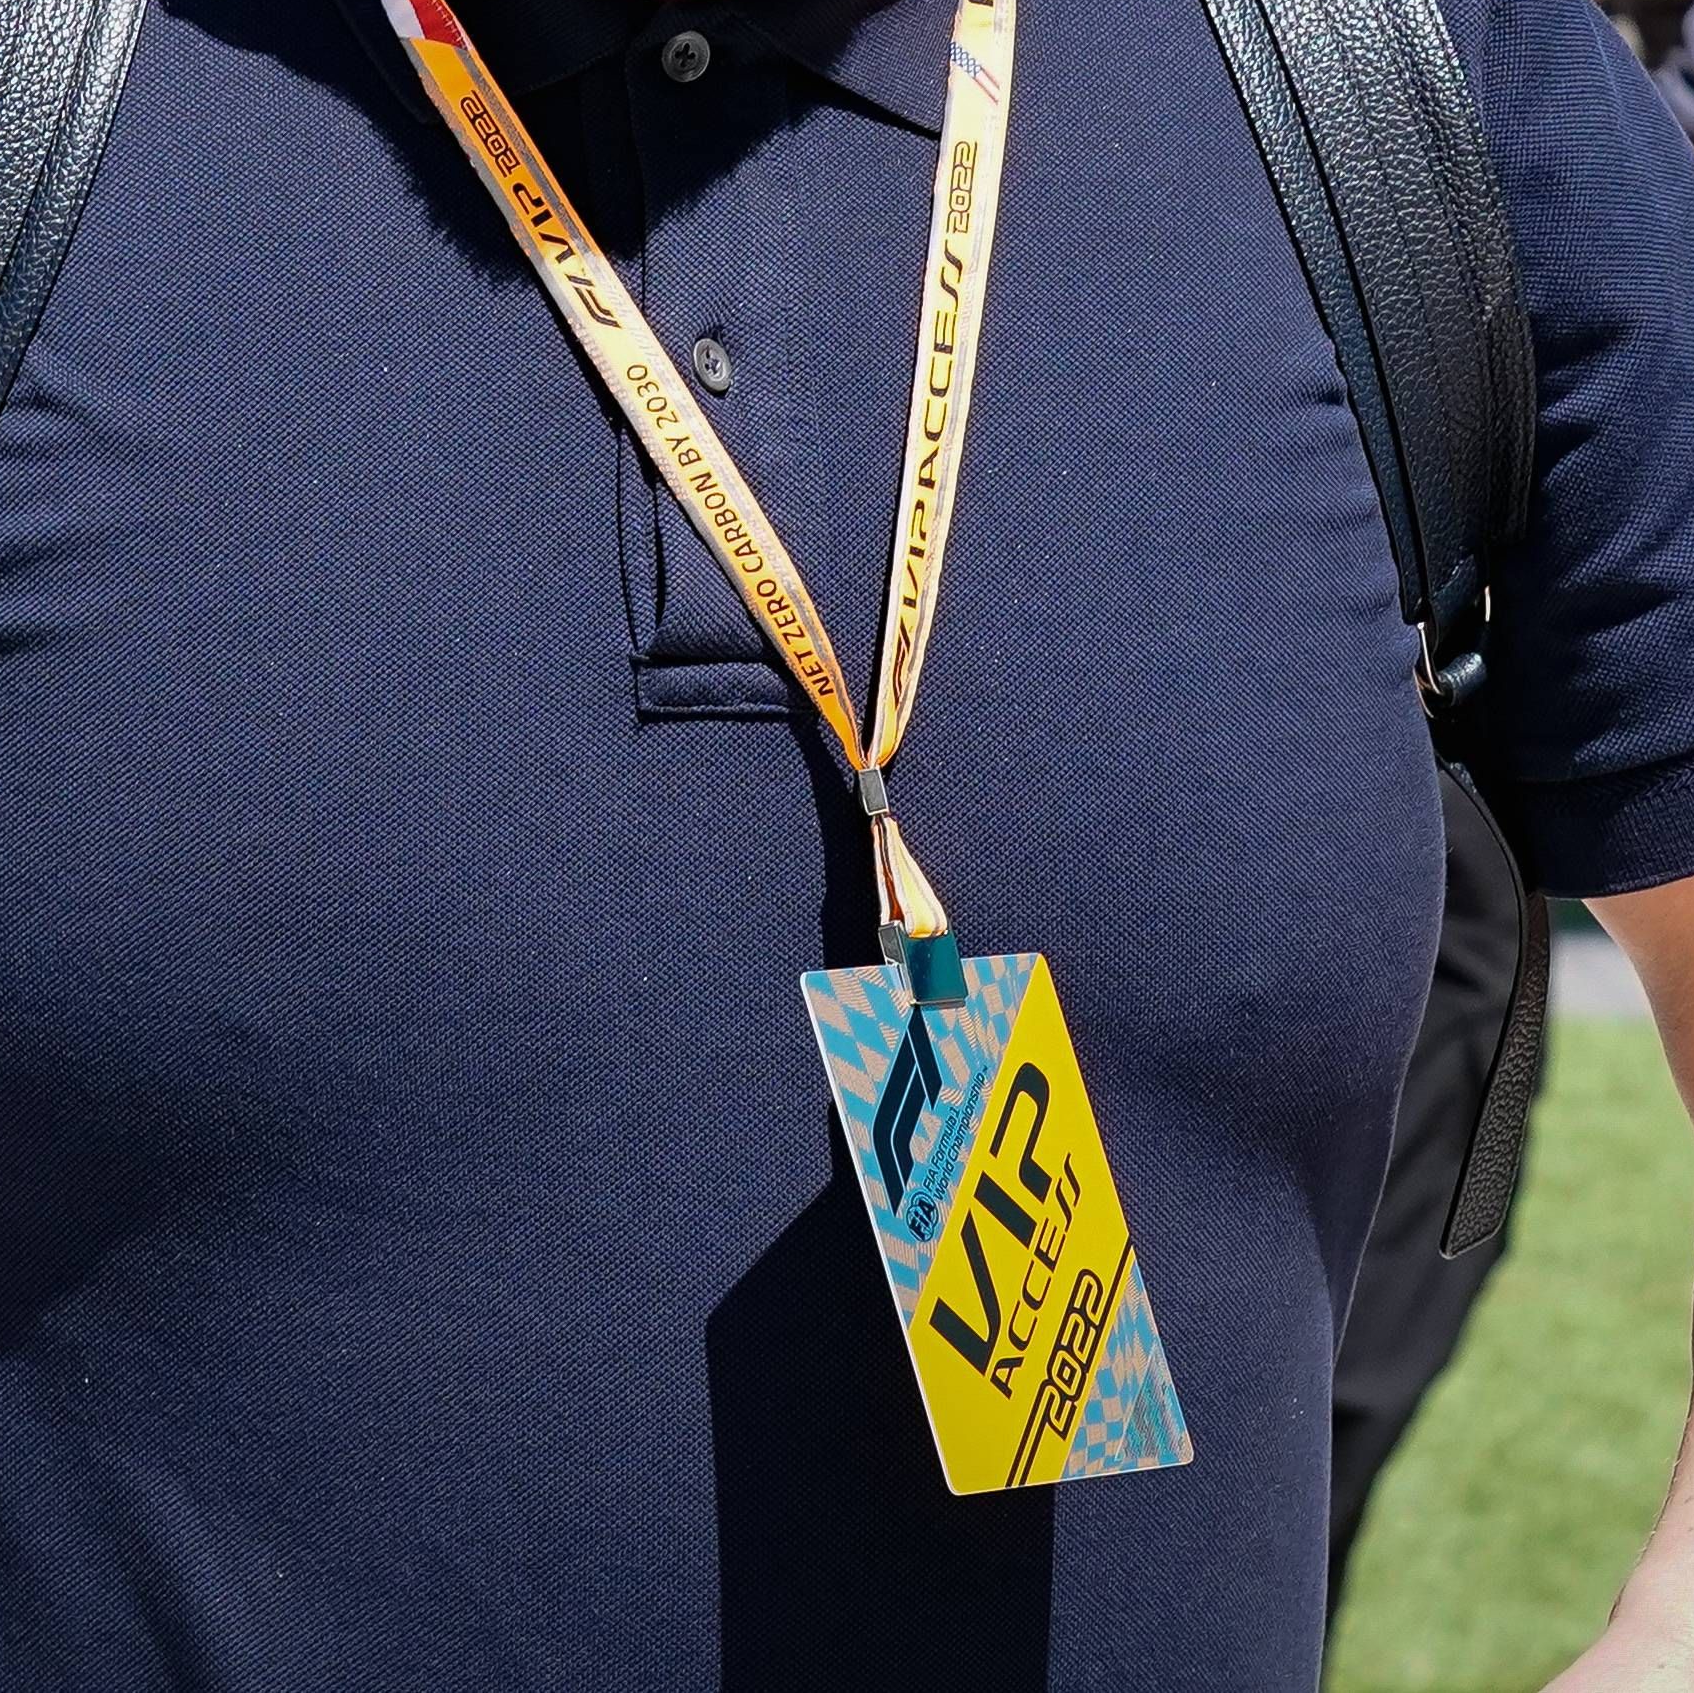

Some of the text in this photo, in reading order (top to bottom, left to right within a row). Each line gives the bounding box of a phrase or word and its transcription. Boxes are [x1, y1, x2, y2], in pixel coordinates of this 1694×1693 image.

[460, 89, 575, 264] VIP 2022
[945, 140, 978, 235] 2022
[626, 364, 680, 430] 2030
[917, 238, 964, 491] ACCESS
[664, 435, 703, 468] BY
[689, 471, 764, 574] CARBON
[902, 498, 927, 609] VIP
[756, 578, 806, 645] ZERO
[794, 648, 836, 697] NET
[922, 1168, 939, 1192] FIA
[930, 1115, 957, 1170] Formula
[933, 1070, 987, 1201] World Championship
[928, 1061, 1053, 1377] VIP
[989, 1152, 1082, 1400] ACCESS
[1041, 1267, 1104, 1441] 2022
